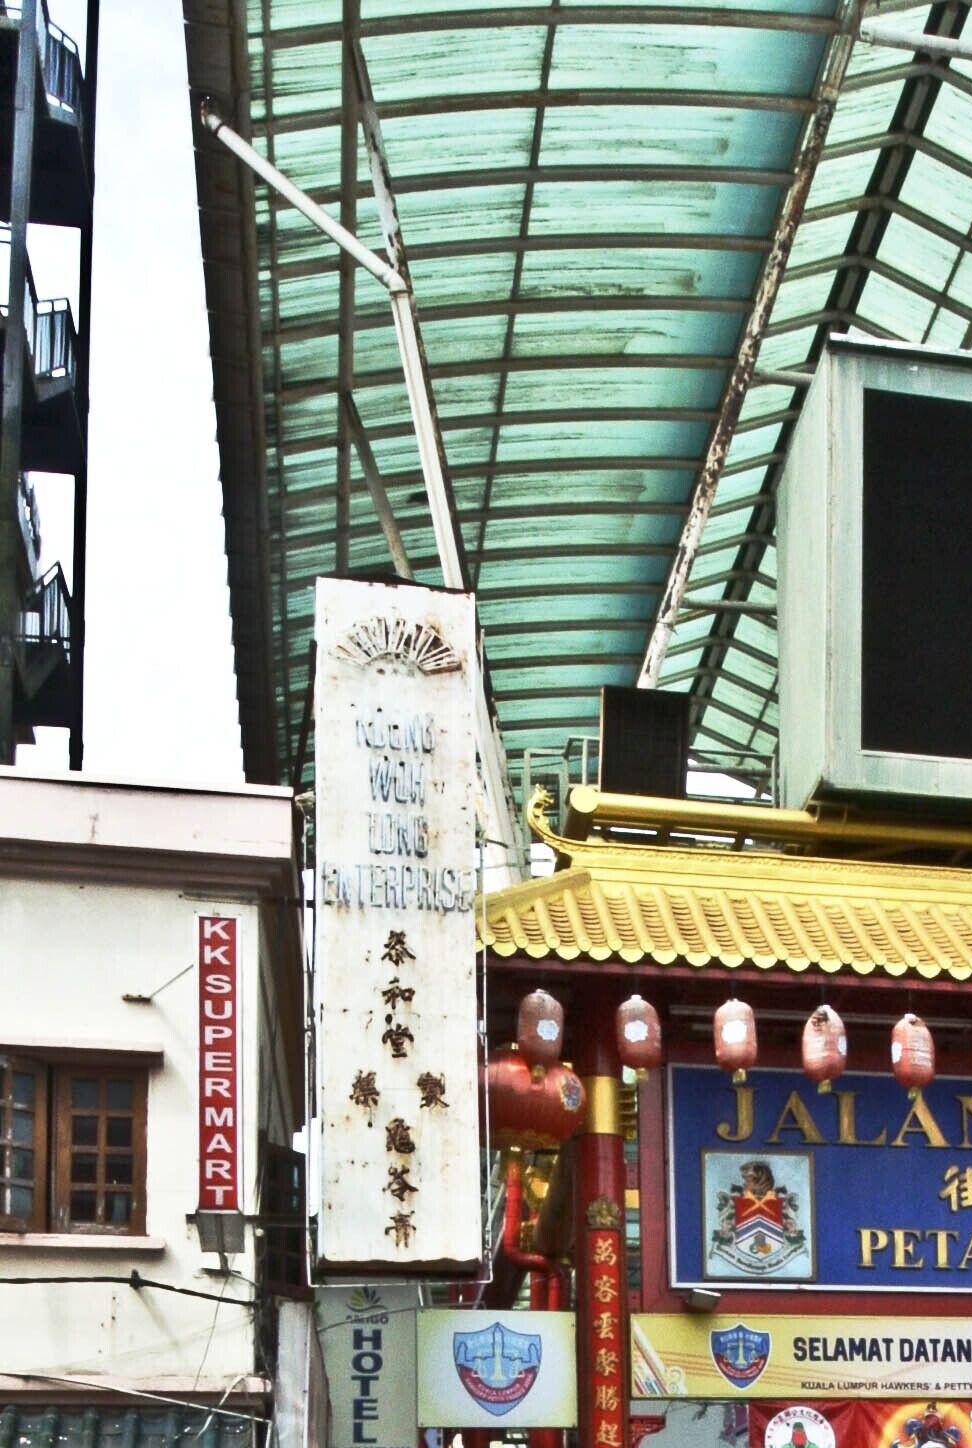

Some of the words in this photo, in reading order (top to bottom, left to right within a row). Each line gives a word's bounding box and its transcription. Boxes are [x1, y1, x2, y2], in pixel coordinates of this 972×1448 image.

[321, 862, 476, 912] ENTERPRISE
[793, 1337, 895, 1362] SELAMAT
[351, 1329, 383, 1444] HOTEL
[801, 1381, 835, 1391] KUALA
[837, 1382, 878, 1391] LUMPUR
[935, 1382, 941, 1391] &
[944, 1382, 972, 1391] PETTY
